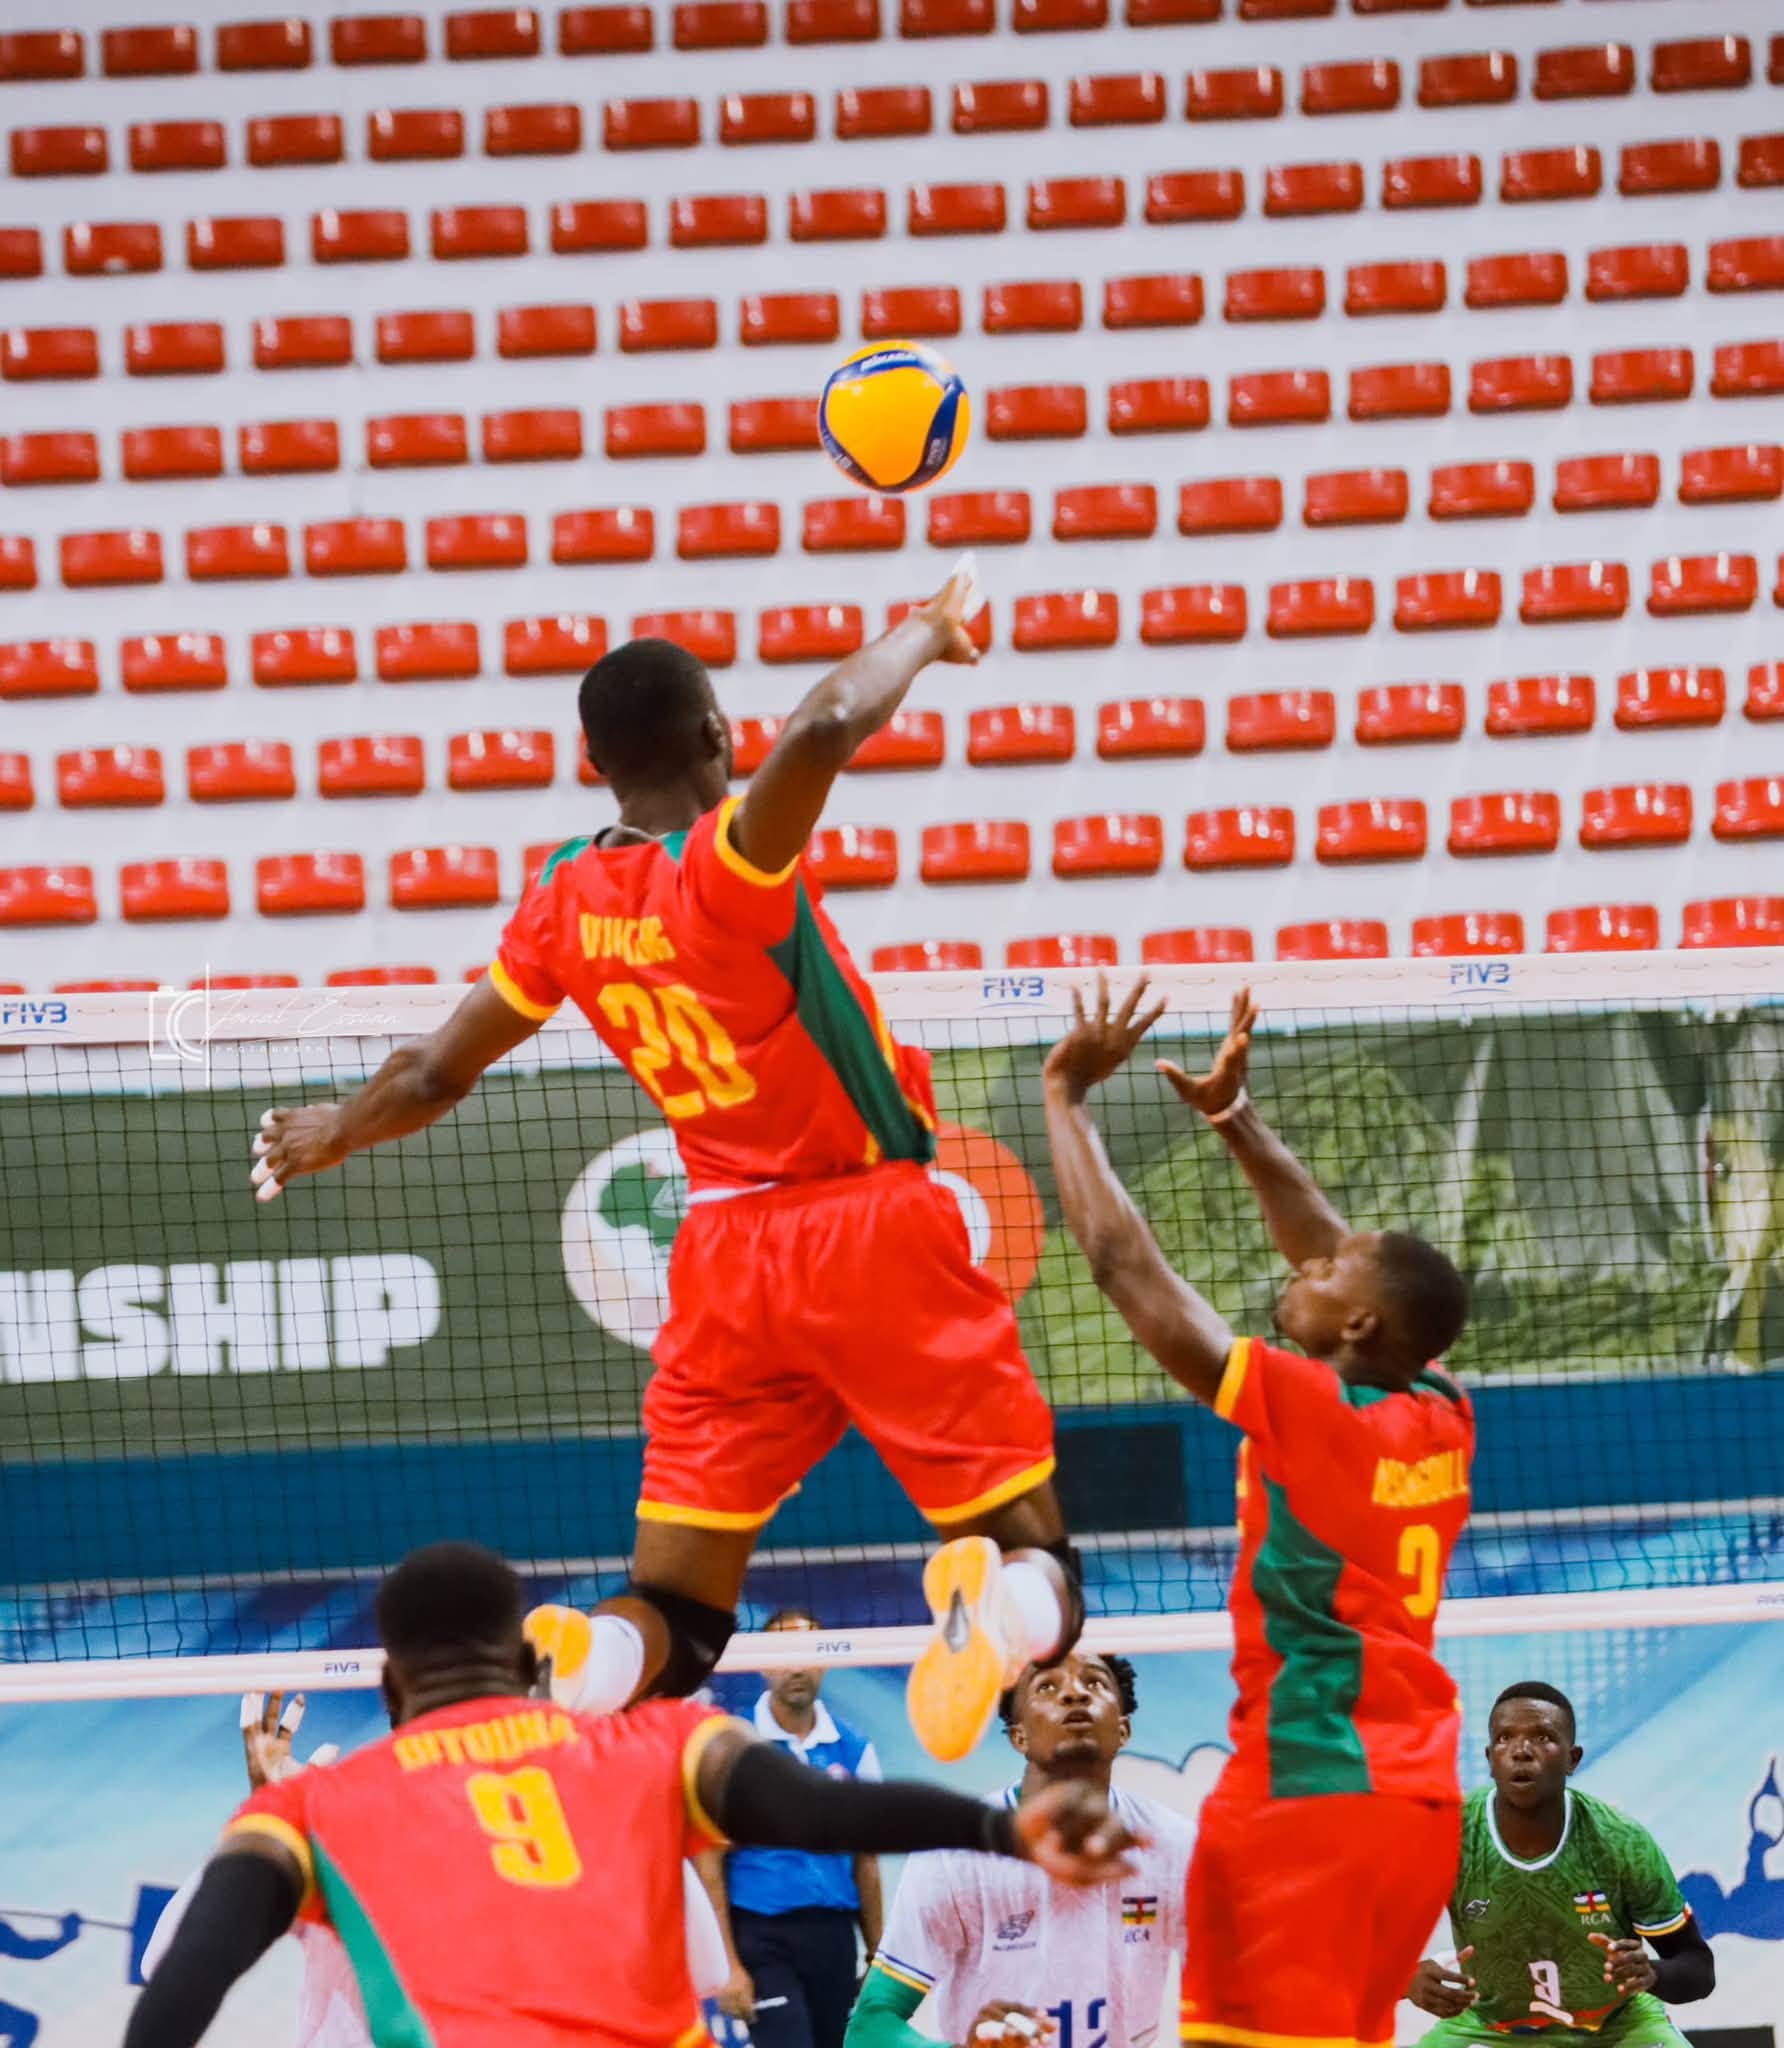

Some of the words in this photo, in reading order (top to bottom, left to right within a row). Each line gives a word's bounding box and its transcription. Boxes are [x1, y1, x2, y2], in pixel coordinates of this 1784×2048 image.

[1449, 963, 1511, 985] FIVB
[982, 975, 1045, 998] FIVB
[3, 1001, 69, 1025] FIVB
[596, 982, 758, 1120] 20
[0, 1254, 441, 1384] NSHIP
[324, 1661, 360, 1673] FIVB
[464, 1765, 583, 1888] 9
[1580, 1913, 1612, 1927] RCA
